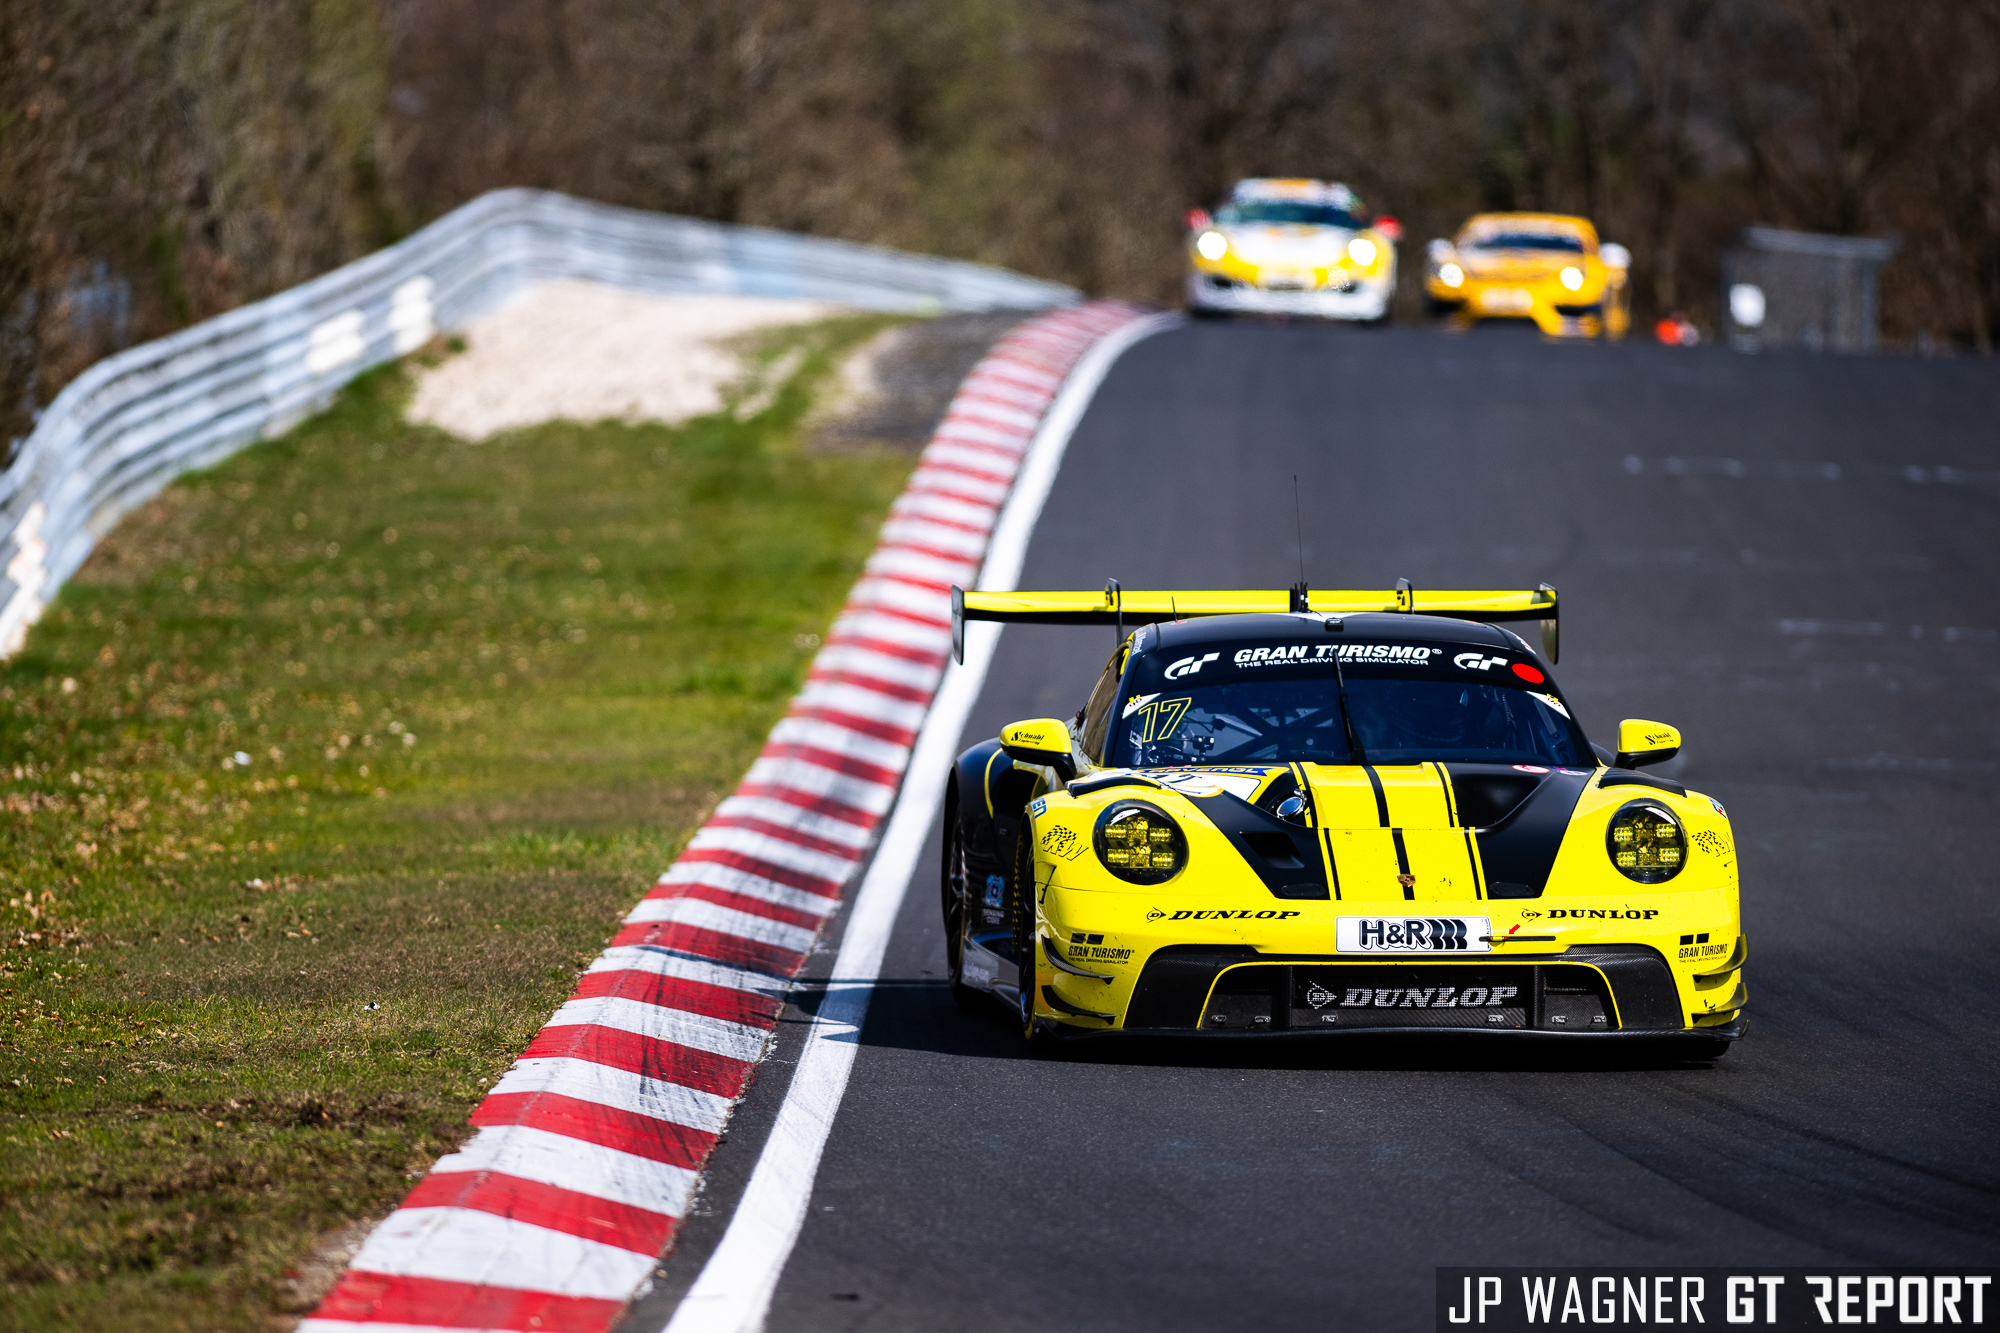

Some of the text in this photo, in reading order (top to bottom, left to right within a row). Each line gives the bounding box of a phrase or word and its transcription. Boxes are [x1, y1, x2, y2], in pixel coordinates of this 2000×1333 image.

[1234, 645, 1309, 663] GRAN
[1264, 658, 1298, 666] REAL
[1355, 656, 1429, 666] SIMULATOR
[1138, 697, 1192, 743] 17
[1168, 910, 1301, 920] DUNLOP
[1547, 909, 1659, 920] DUNLOP
[1360, 919, 1431, 949] H&R
[1068, 945, 1090, 957] GRAN
[1678, 946, 1699, 958] GRAN
[1339, 986, 1518, 1008] DUNLOP
